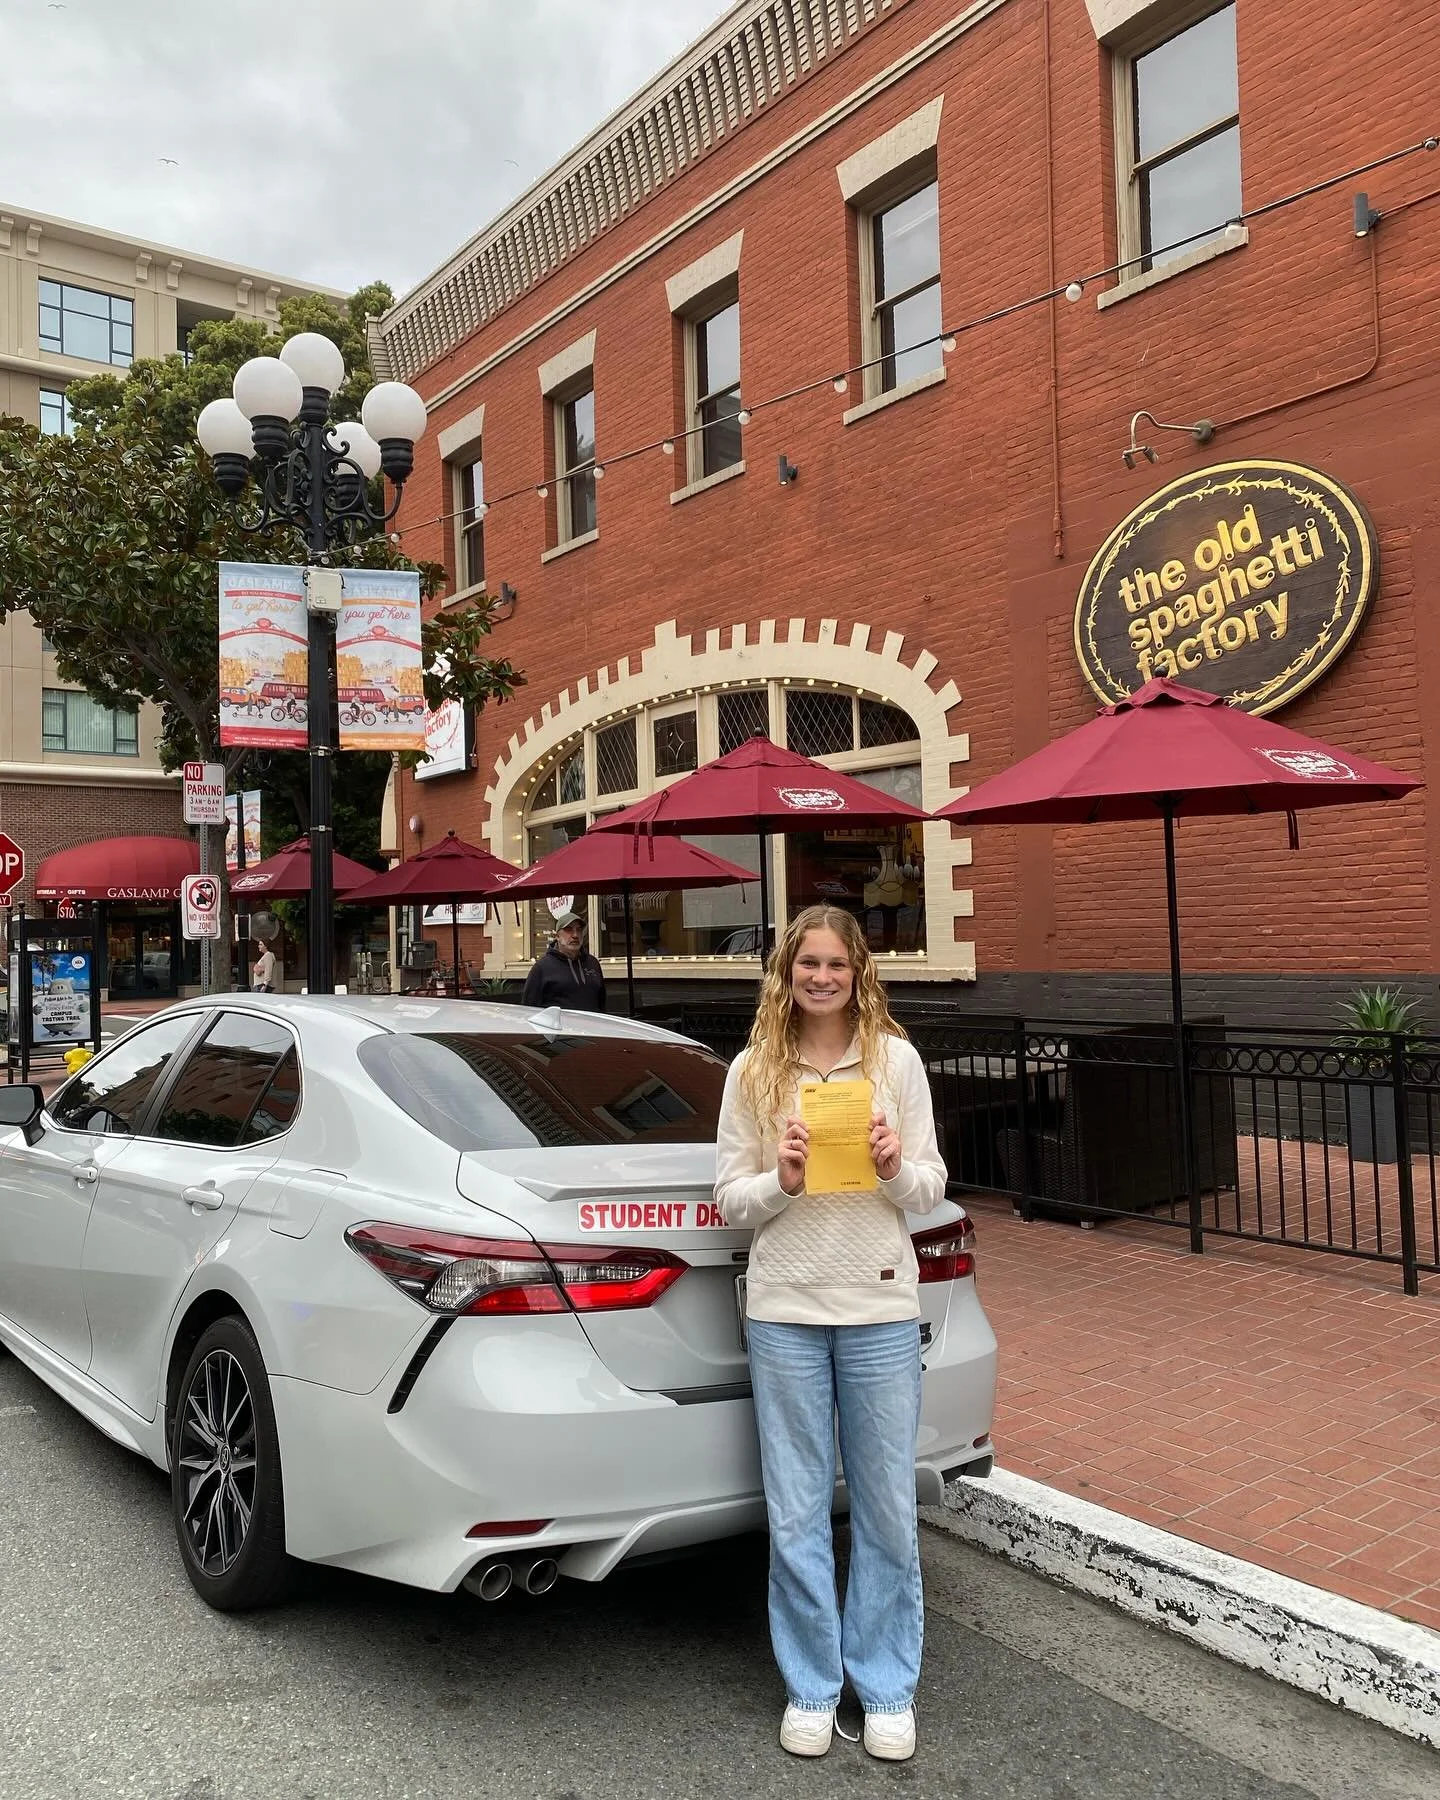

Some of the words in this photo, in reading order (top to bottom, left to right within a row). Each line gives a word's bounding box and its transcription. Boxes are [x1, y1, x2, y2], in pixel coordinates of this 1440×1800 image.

[1118, 560, 1187, 613] the
[1194, 504, 1262, 572] old
[1128, 518, 1324, 649] spaghetti
[232, 599, 243, 609] to
[246, 599, 265, 616] get
[344, 609, 366, 623] you
[368, 606, 385, 624] get
[386, 606, 412, 620] here
[1136, 592, 1288, 681] factory
[187, 765, 201, 779] NO
[187, 784, 222, 796] PARKING
[107, 887, 169, 898] GASLAMP
[60, 907, 75, 918] STO
[189, 913, 198, 921] NO
[199, 922, 212, 930] ZONE
[580, 1204, 687, 1229] STUDENT
